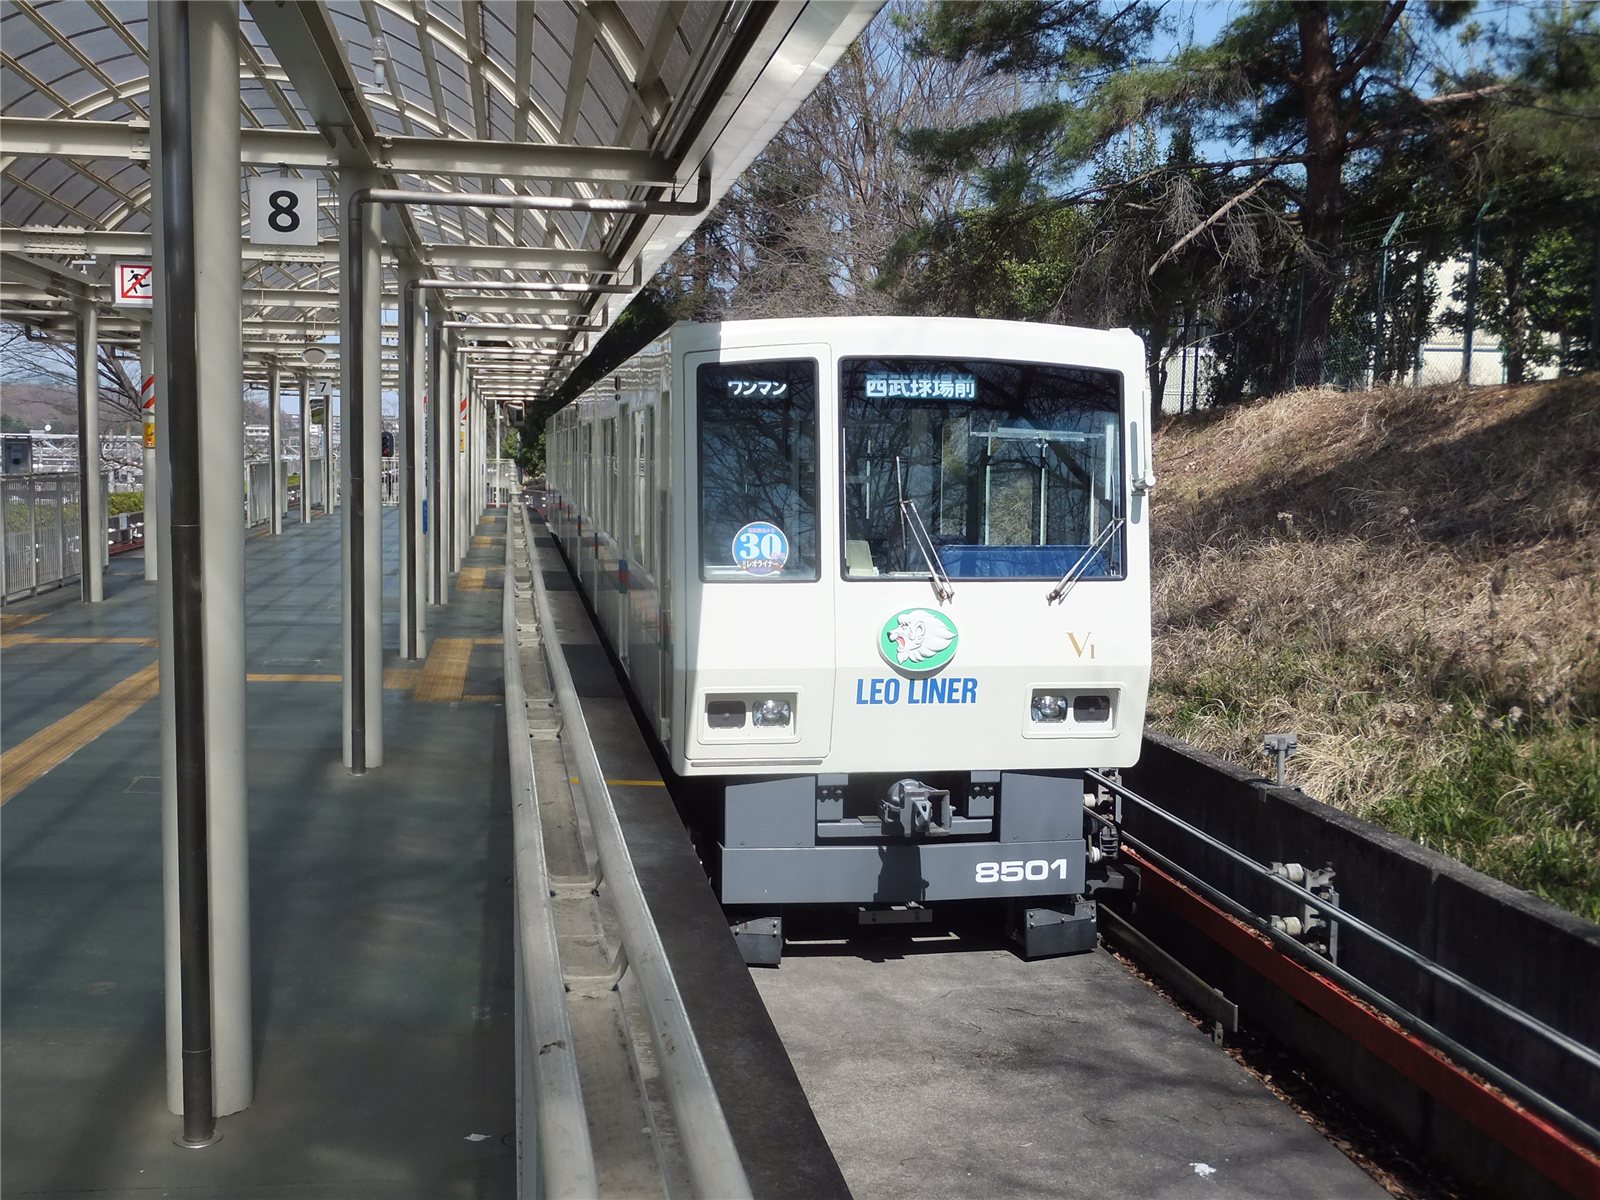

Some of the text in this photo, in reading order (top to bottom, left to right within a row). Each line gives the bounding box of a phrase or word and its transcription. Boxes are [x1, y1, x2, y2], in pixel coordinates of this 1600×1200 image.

[268, 190, 300, 233] 8
[319, 381, 327, 393] 7
[728, 381, 787, 395] ワンマン
[866, 374, 975, 398] 西武球場前
[740, 532, 782, 560] 30
[856, 677, 978, 705] LEO LINER
[975, 858, 1068, 883] 8501
